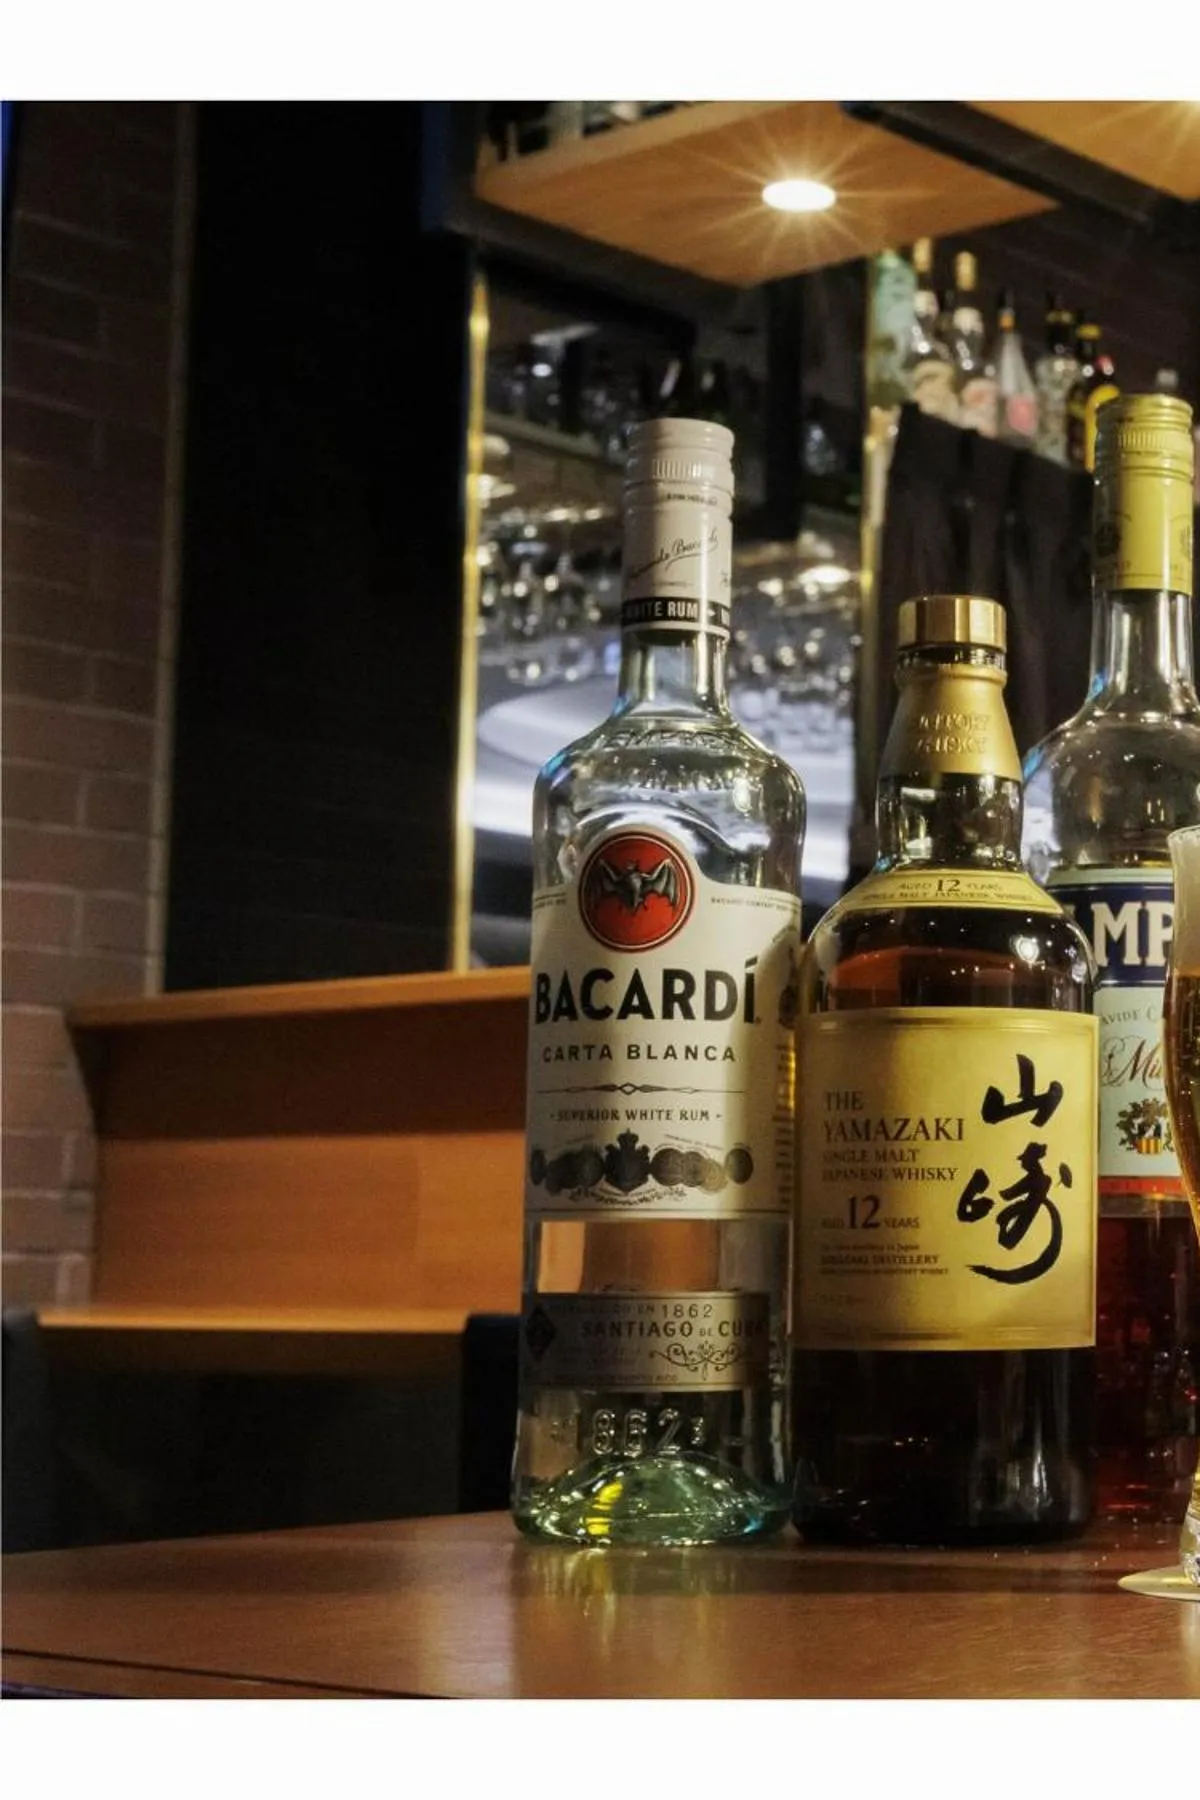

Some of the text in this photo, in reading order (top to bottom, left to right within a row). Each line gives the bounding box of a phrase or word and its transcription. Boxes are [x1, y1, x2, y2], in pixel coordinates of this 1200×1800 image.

[667, 601, 698, 618] RUM
[937, 879, 961, 892] 12
[1063, 901, 1174, 967] MP
[535, 956, 757, 1024] BACARDÍ
[543, 1044, 736, 1063] CARTA BLANCA
[826, 1090, 864, 1111] THE
[558, 1109, 710, 1121] SUPERIOR WHITE RUM
[823, 1116, 965, 1142] YAMAZAKI
[874, 1149, 920, 1162] MALT
[822, 1167, 958, 1182] JAPANESE WHISKY
[848, 1194, 882, 1229] 12
[884, 1217, 920, 1229] YEARS
[661, 1303, 713, 1319] 1862
[582, 1320, 693, 1338] SANTIAGO
